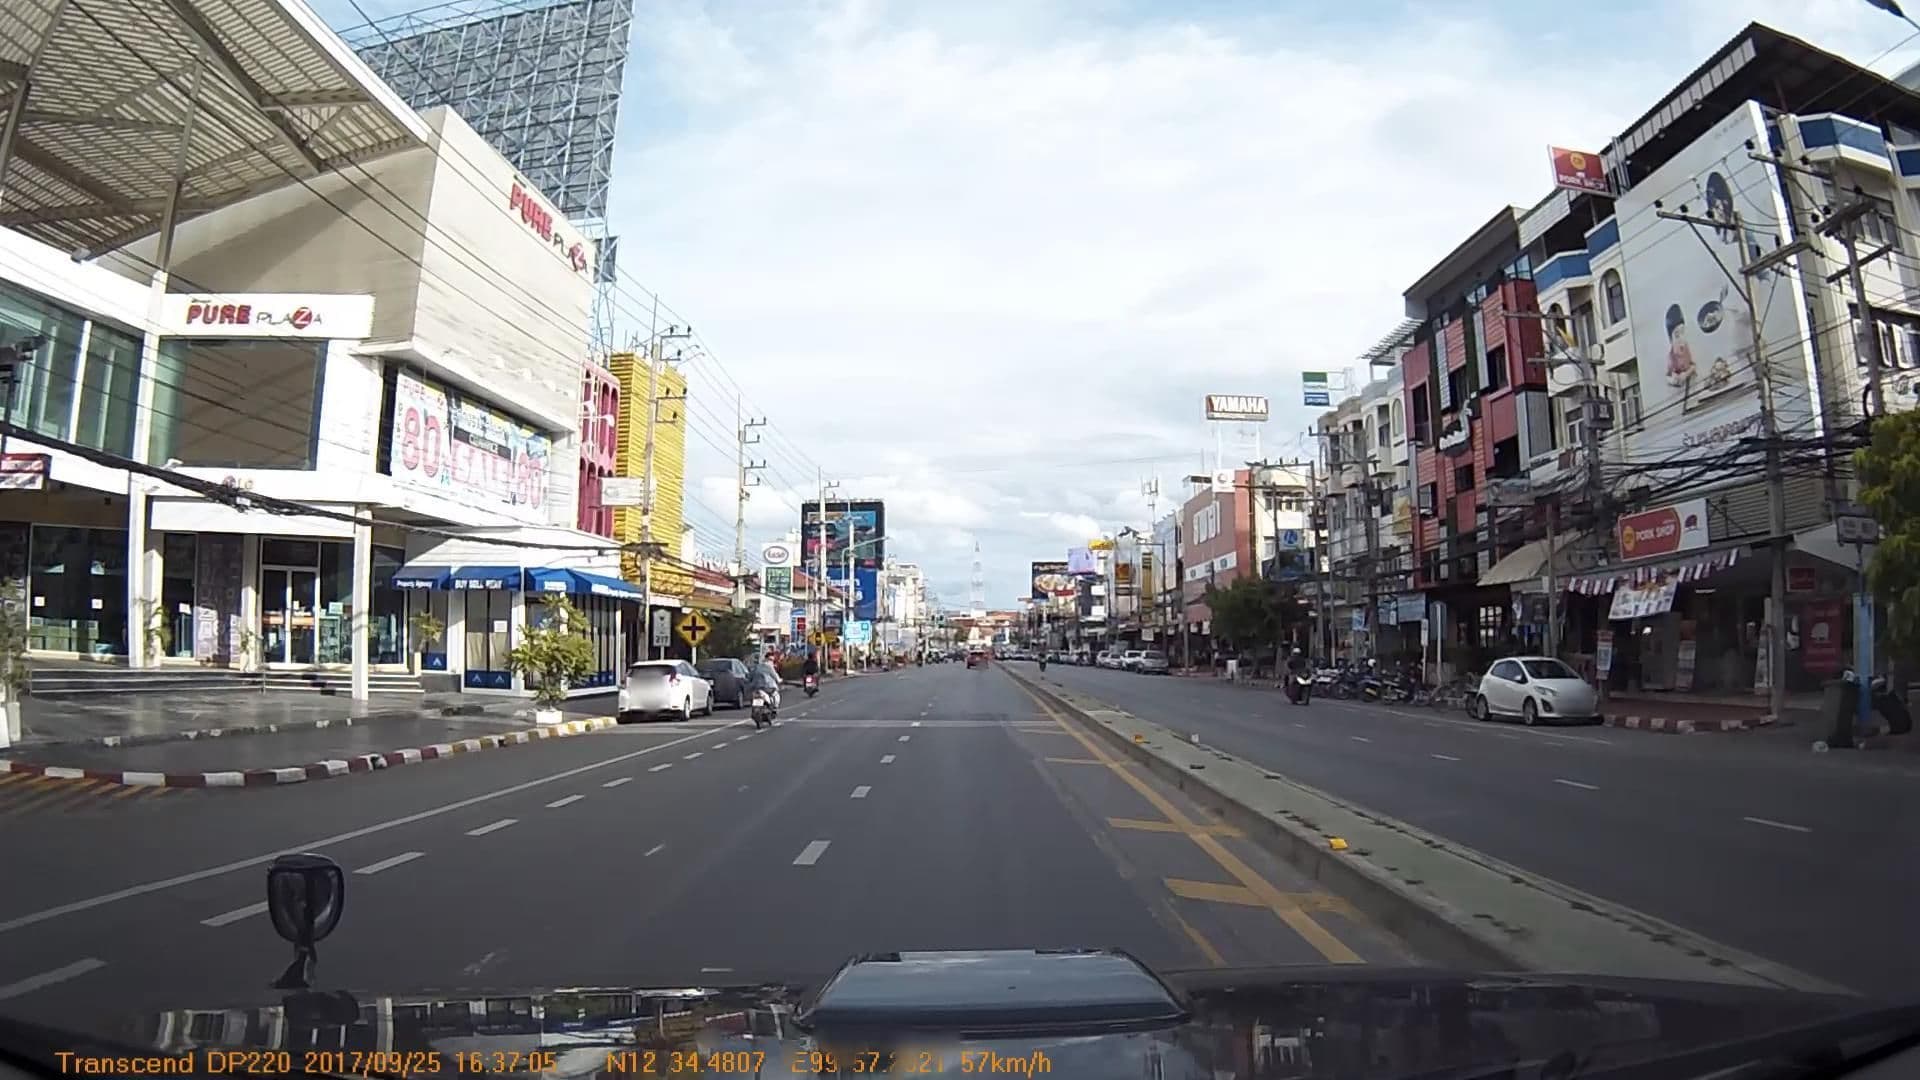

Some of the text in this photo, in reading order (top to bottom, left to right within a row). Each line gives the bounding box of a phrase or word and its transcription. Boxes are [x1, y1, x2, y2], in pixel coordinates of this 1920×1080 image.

[509, 182, 589, 274] PURE PLAZA
[186, 304, 322, 329] PURE PLAZA
[1211, 396, 1267, 413] YAMAHA
[402, 407, 442, 478] 80
[450, 440, 512, 497] SALE
[1636, 528, 1655, 541] PORK
[1655, 524, 1676, 538] SHOP
[454, 579, 503, 589] BUY SELL RENT
